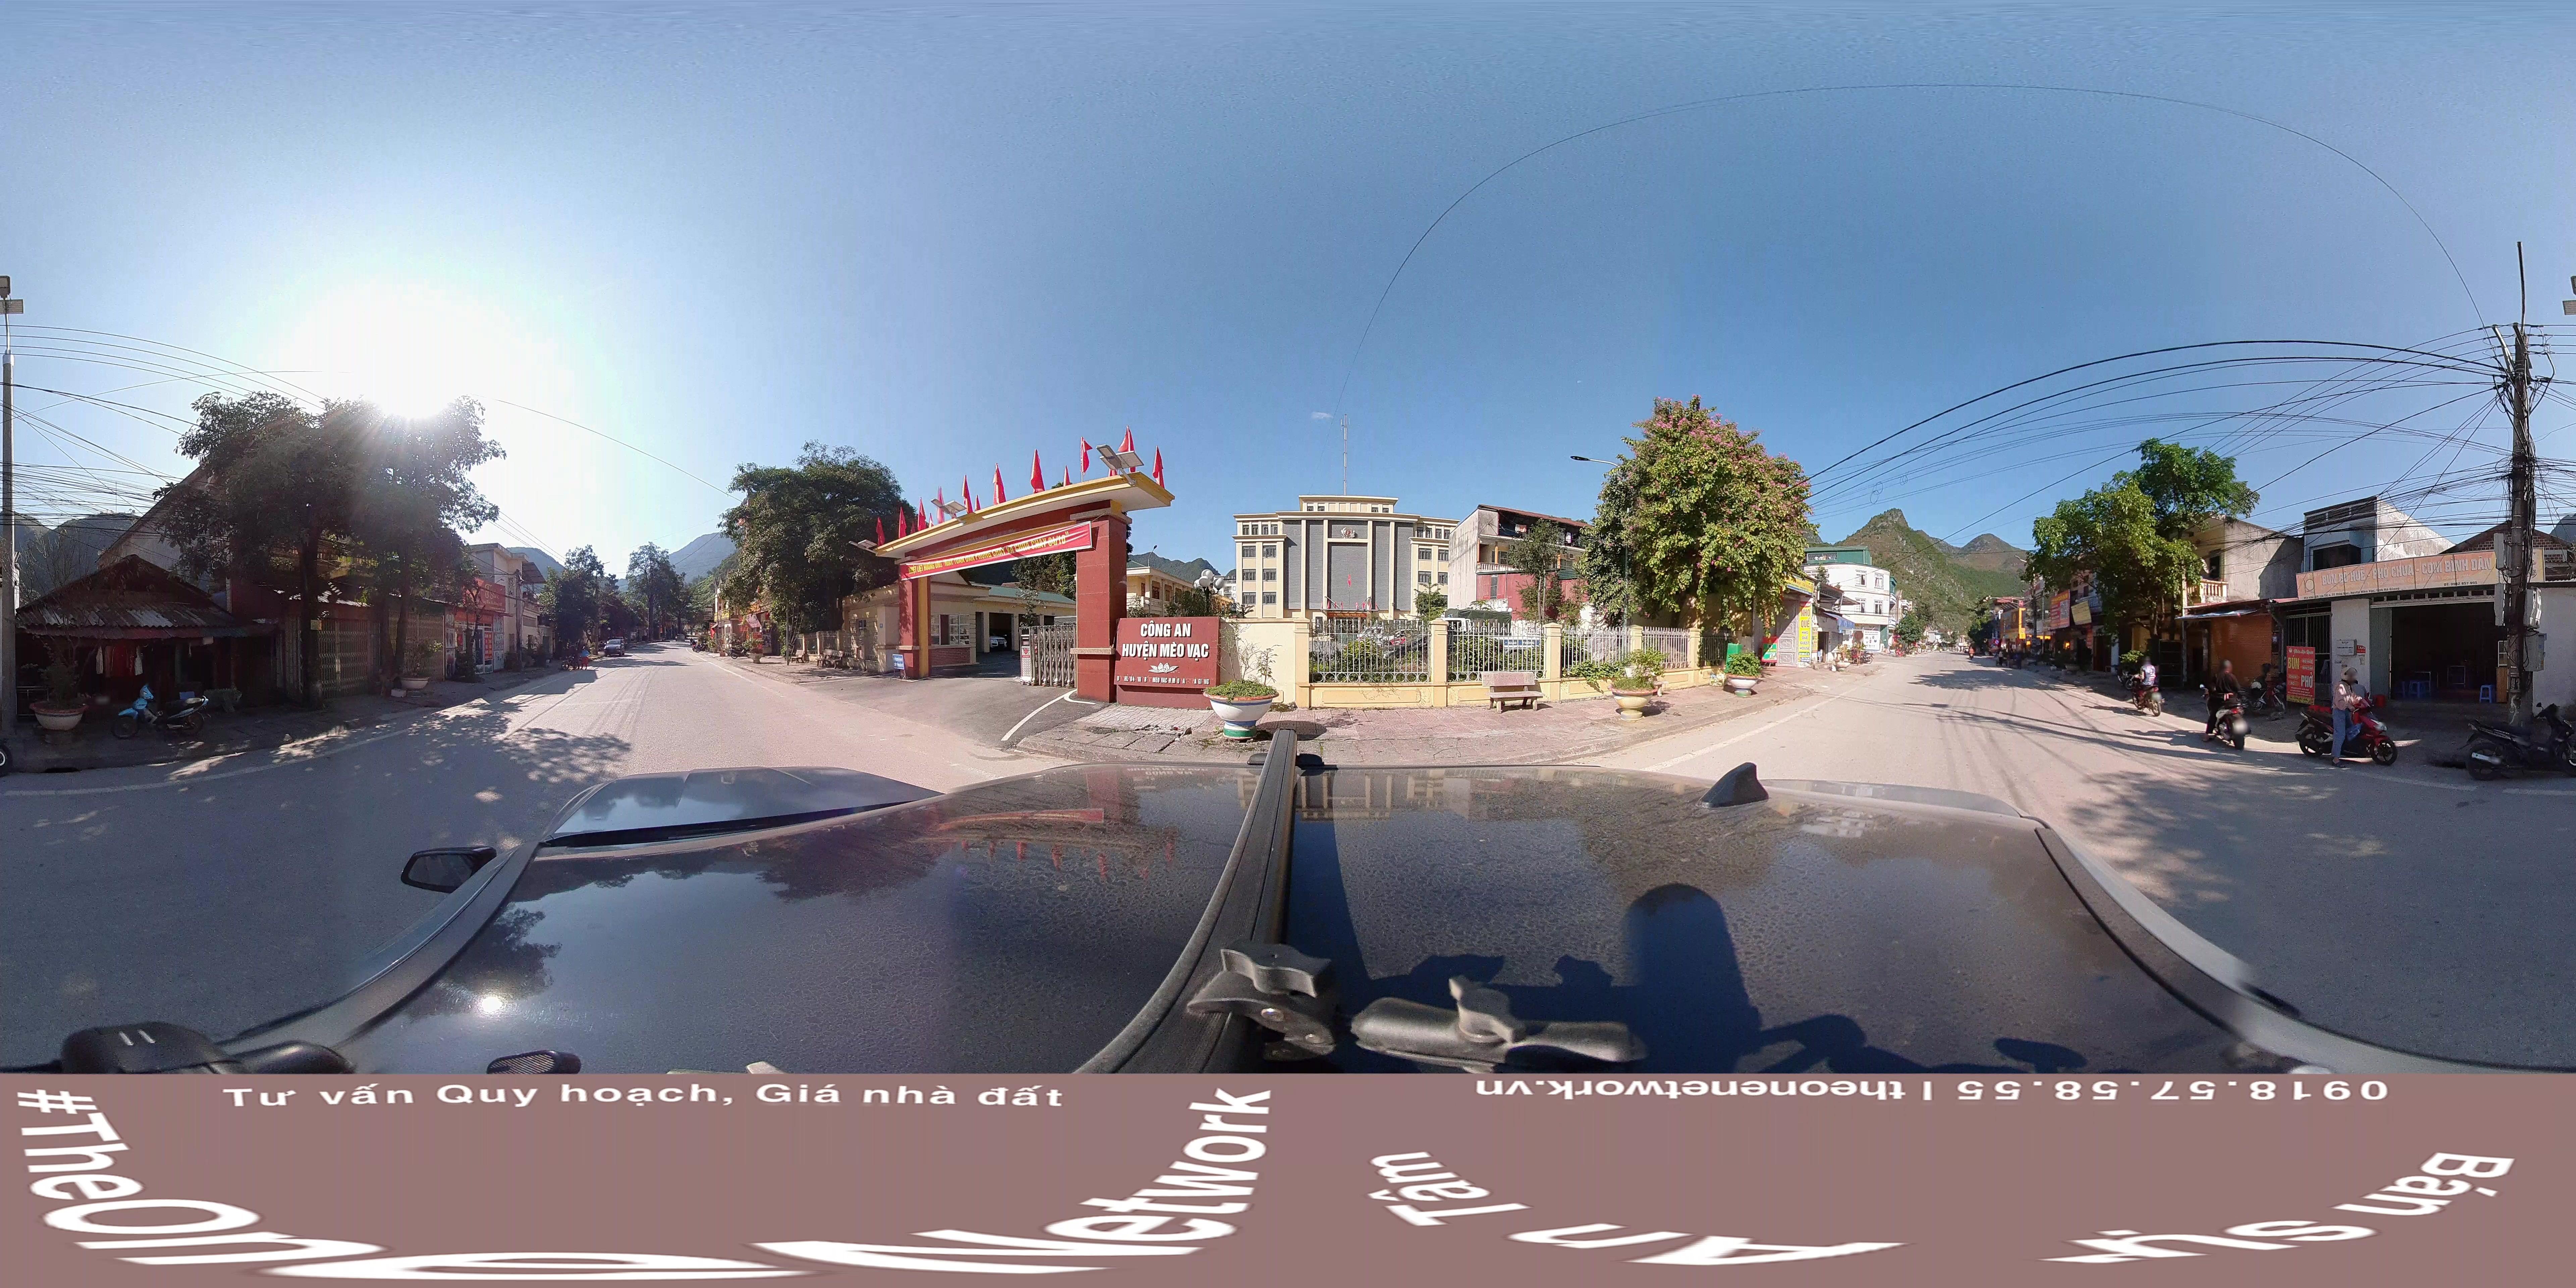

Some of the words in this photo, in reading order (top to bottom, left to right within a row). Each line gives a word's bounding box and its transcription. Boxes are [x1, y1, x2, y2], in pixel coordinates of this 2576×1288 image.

[2471, 556, 2491, 571] DÂN
[1140, 620, 1171, 637] CÔNG
[1174, 623, 1191, 637] AN
[1122, 640, 1158, 660] HUYỆN
[1160, 641, 1185, 658] MÈO
[1187, 643, 1209, 661] VẠC
[2288, 655, 2300, 669] BÚN
[2301, 672, 2313, 688] PHỞ
